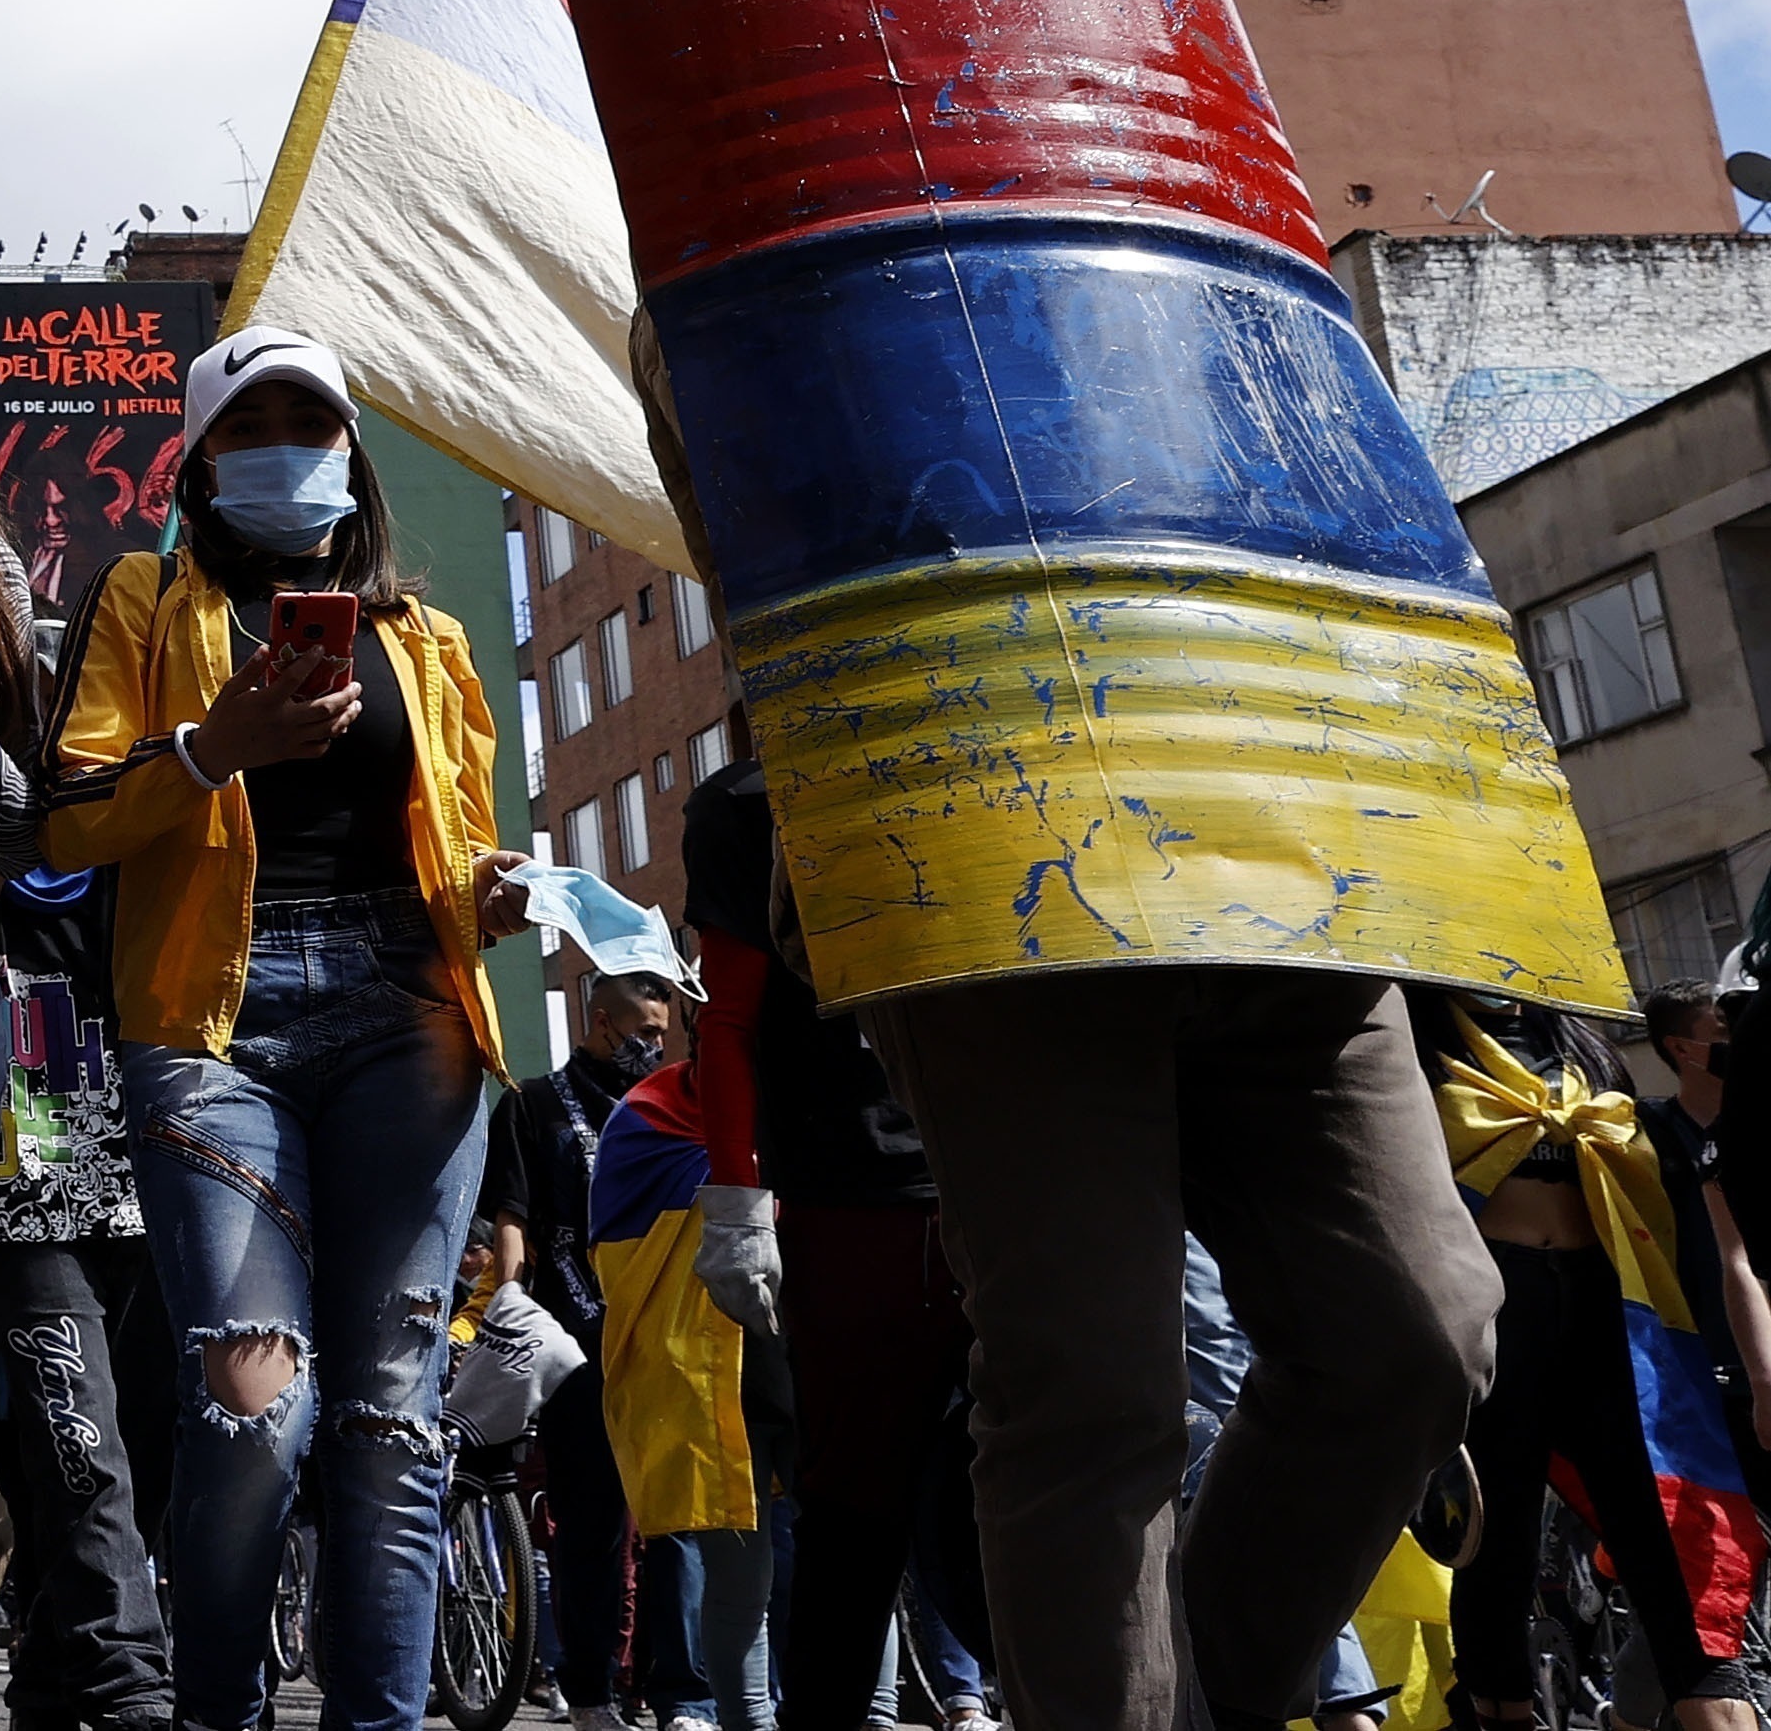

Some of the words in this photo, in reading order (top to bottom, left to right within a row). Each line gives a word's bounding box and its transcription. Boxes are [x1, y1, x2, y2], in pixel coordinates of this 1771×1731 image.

[1, 316, 37, 344] LA
[39, 302, 163, 347] CALLE
[36, 346, 178, 393] TERROR
[3, 400, 21, 414] 16
[24, 401, 45, 414] DE
[48, 401, 95, 415] JULIO
[117, 398, 182, 416] NETFLIX
[8, 1315, 101, 1495] Yankees
